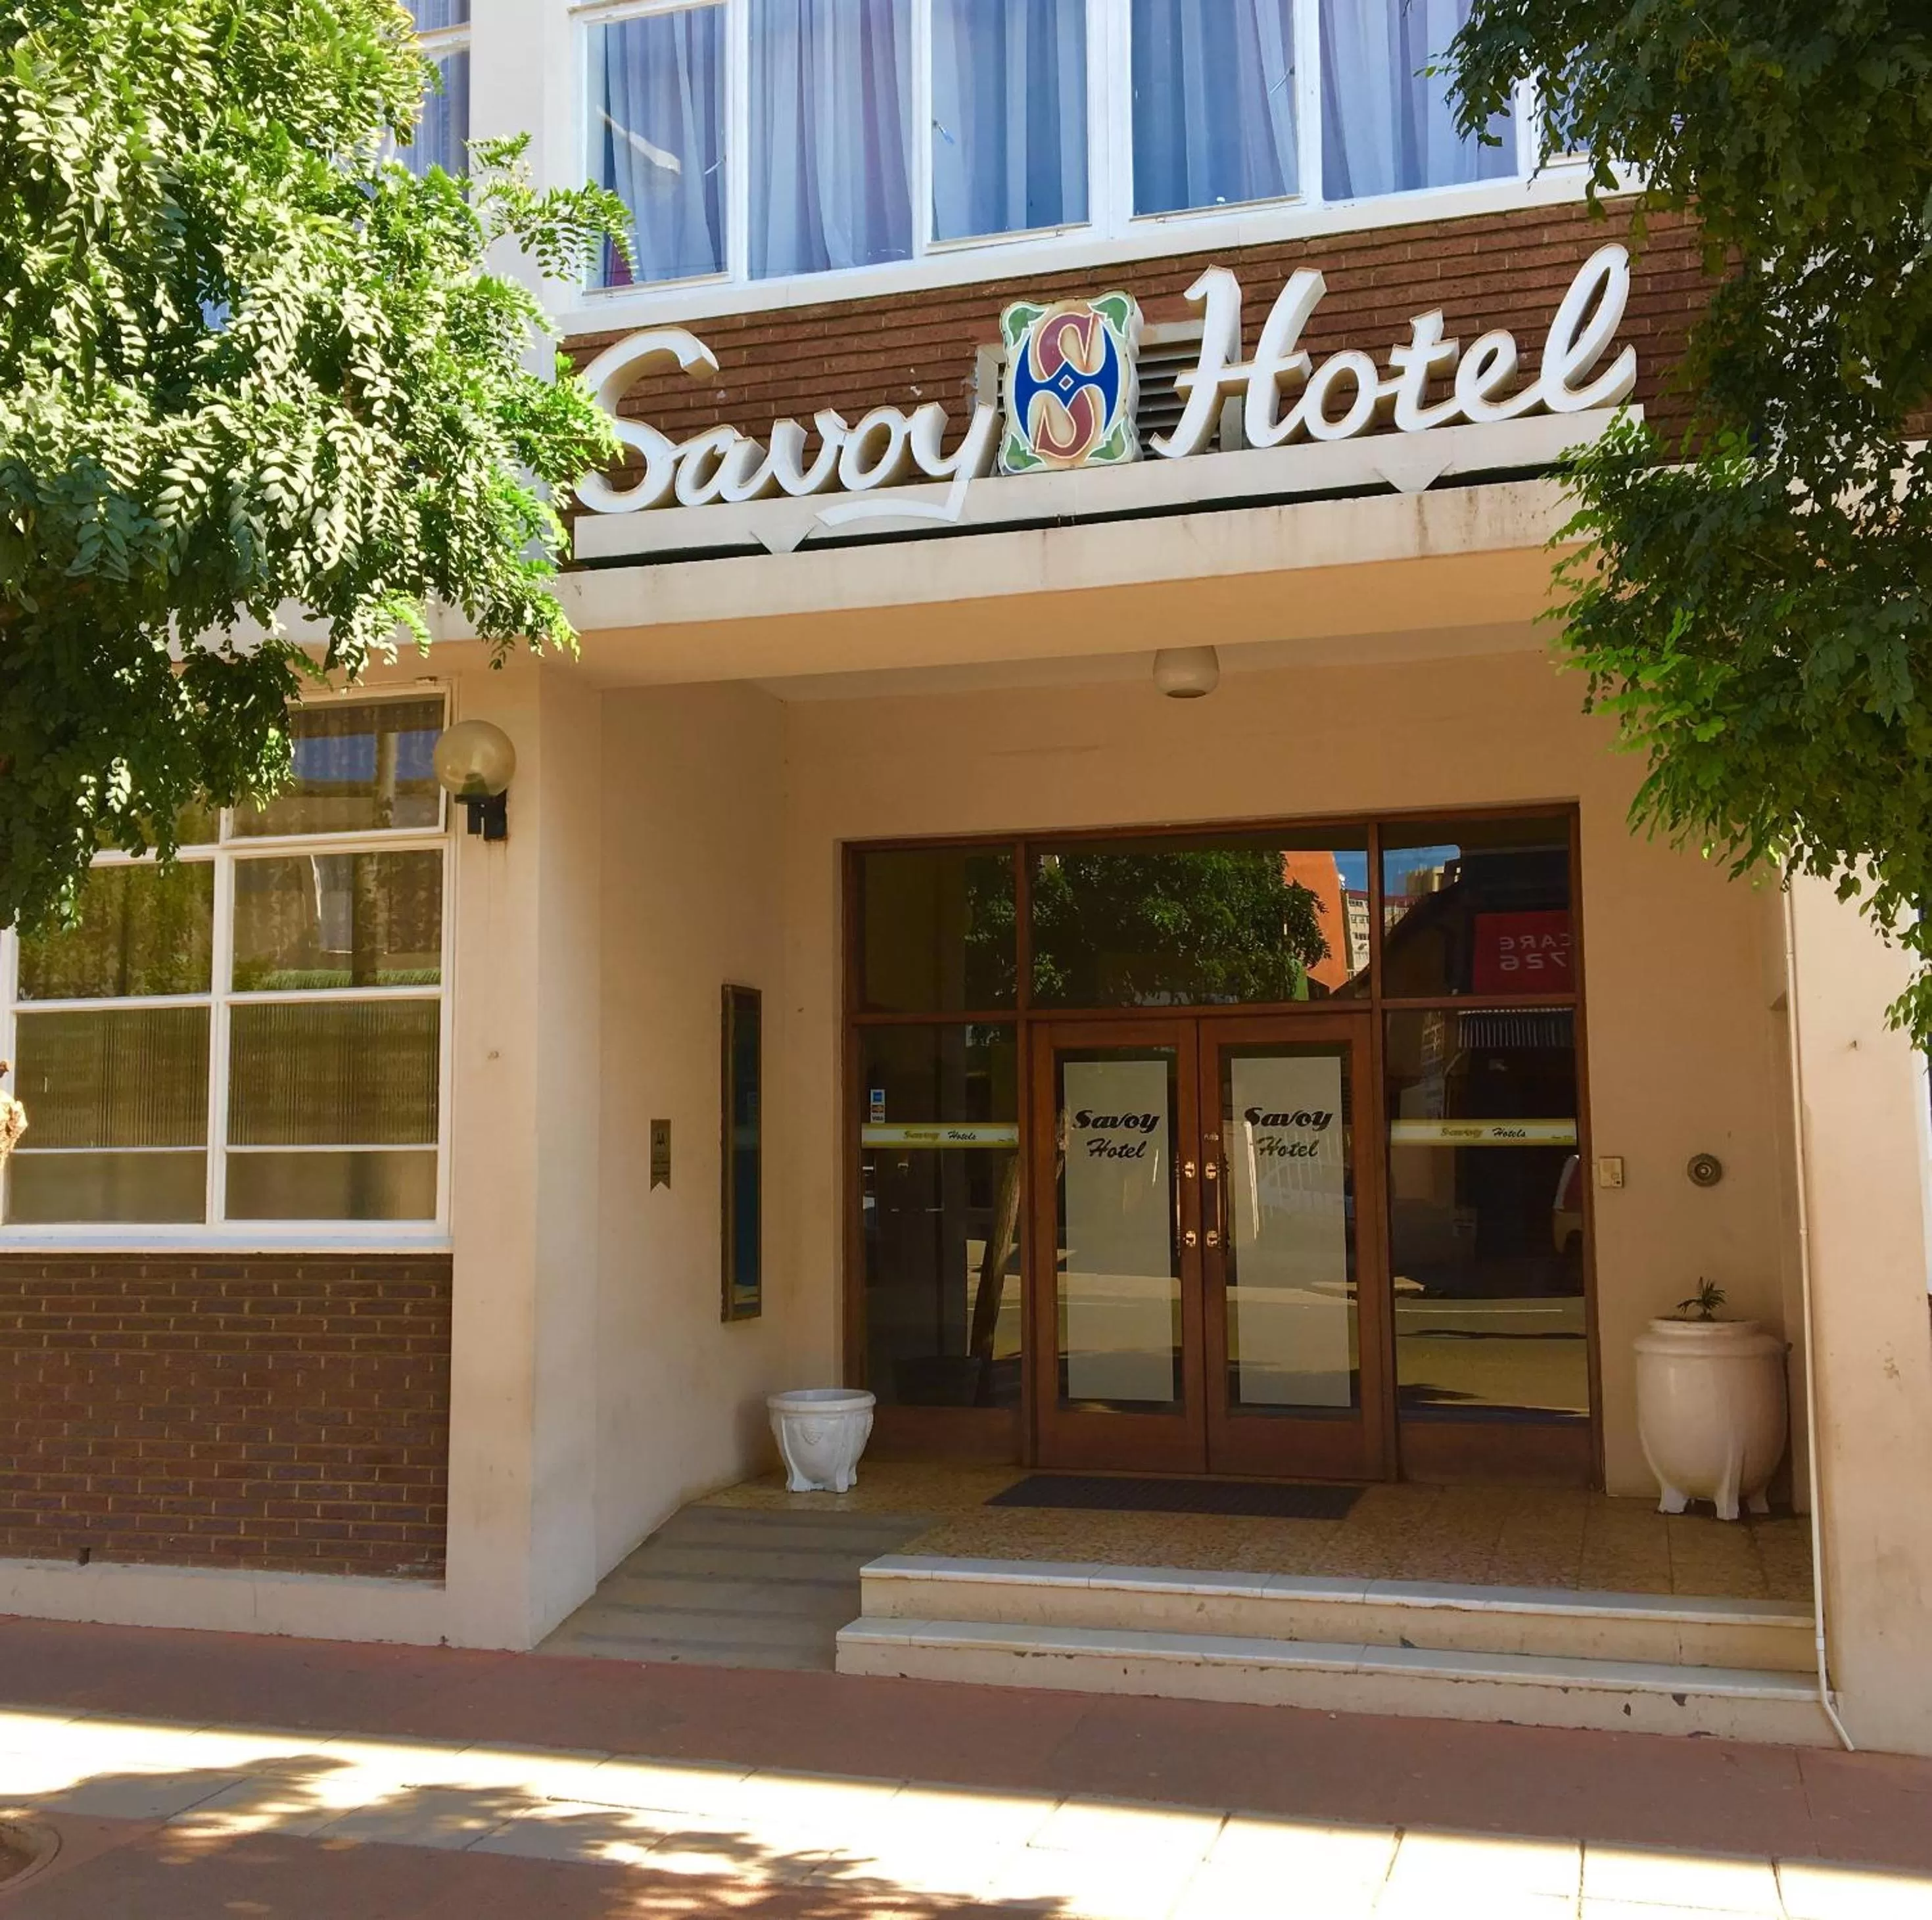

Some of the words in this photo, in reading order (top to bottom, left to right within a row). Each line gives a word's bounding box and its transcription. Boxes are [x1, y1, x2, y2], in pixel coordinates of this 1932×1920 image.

[575, 327, 1003, 526] Savoy
[1150, 243, 1636, 457] Hotel
[1073, 1110, 1160, 1133] Savoy
[1244, 1108, 1333, 1131] Savoy
[948, 1130, 977, 1140] Hotels
[1492, 1127, 1525, 1138] Hotels
[1087, 1138, 1146, 1158] Hotel
[1258, 1136, 1319, 1158] Hotel
